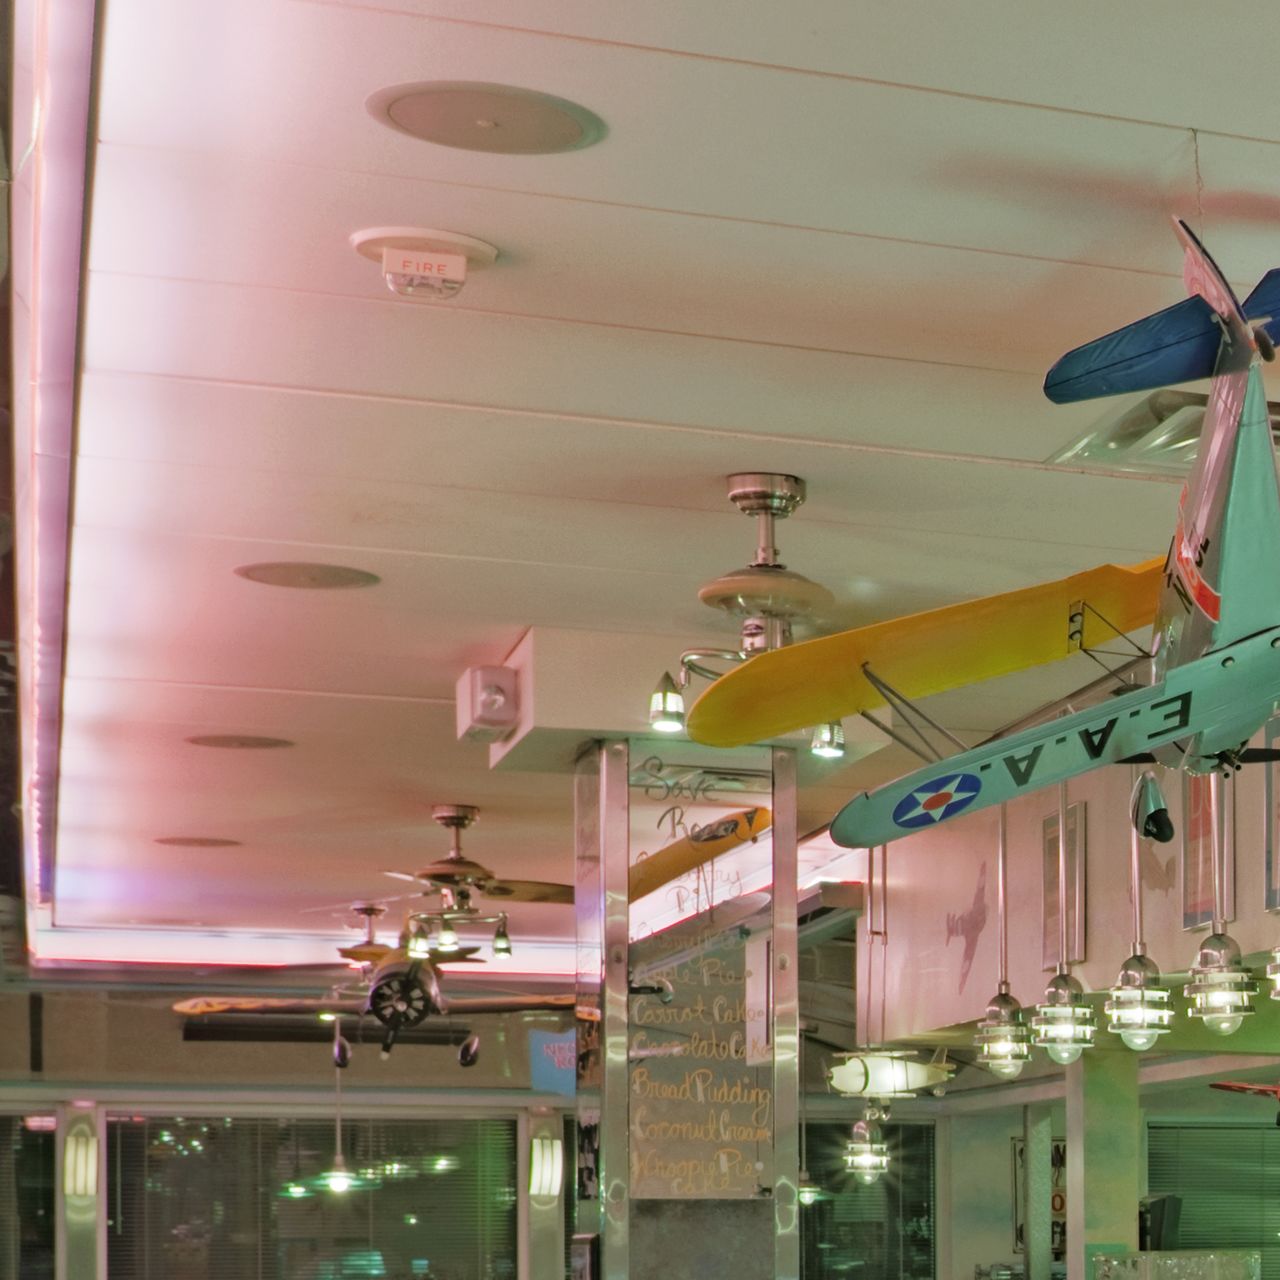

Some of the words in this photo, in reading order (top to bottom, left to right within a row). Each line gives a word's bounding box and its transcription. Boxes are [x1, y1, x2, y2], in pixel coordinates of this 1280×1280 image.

[401, 259, 448, 275] FIRE
[642, 755, 720, 801] Save
[632, 994, 712, 1025] Carrot
[632, 1067, 691, 1099] Bread
[690, 1067, 772, 1127] Pudding
[632, 1104, 720, 1141] Coconut
